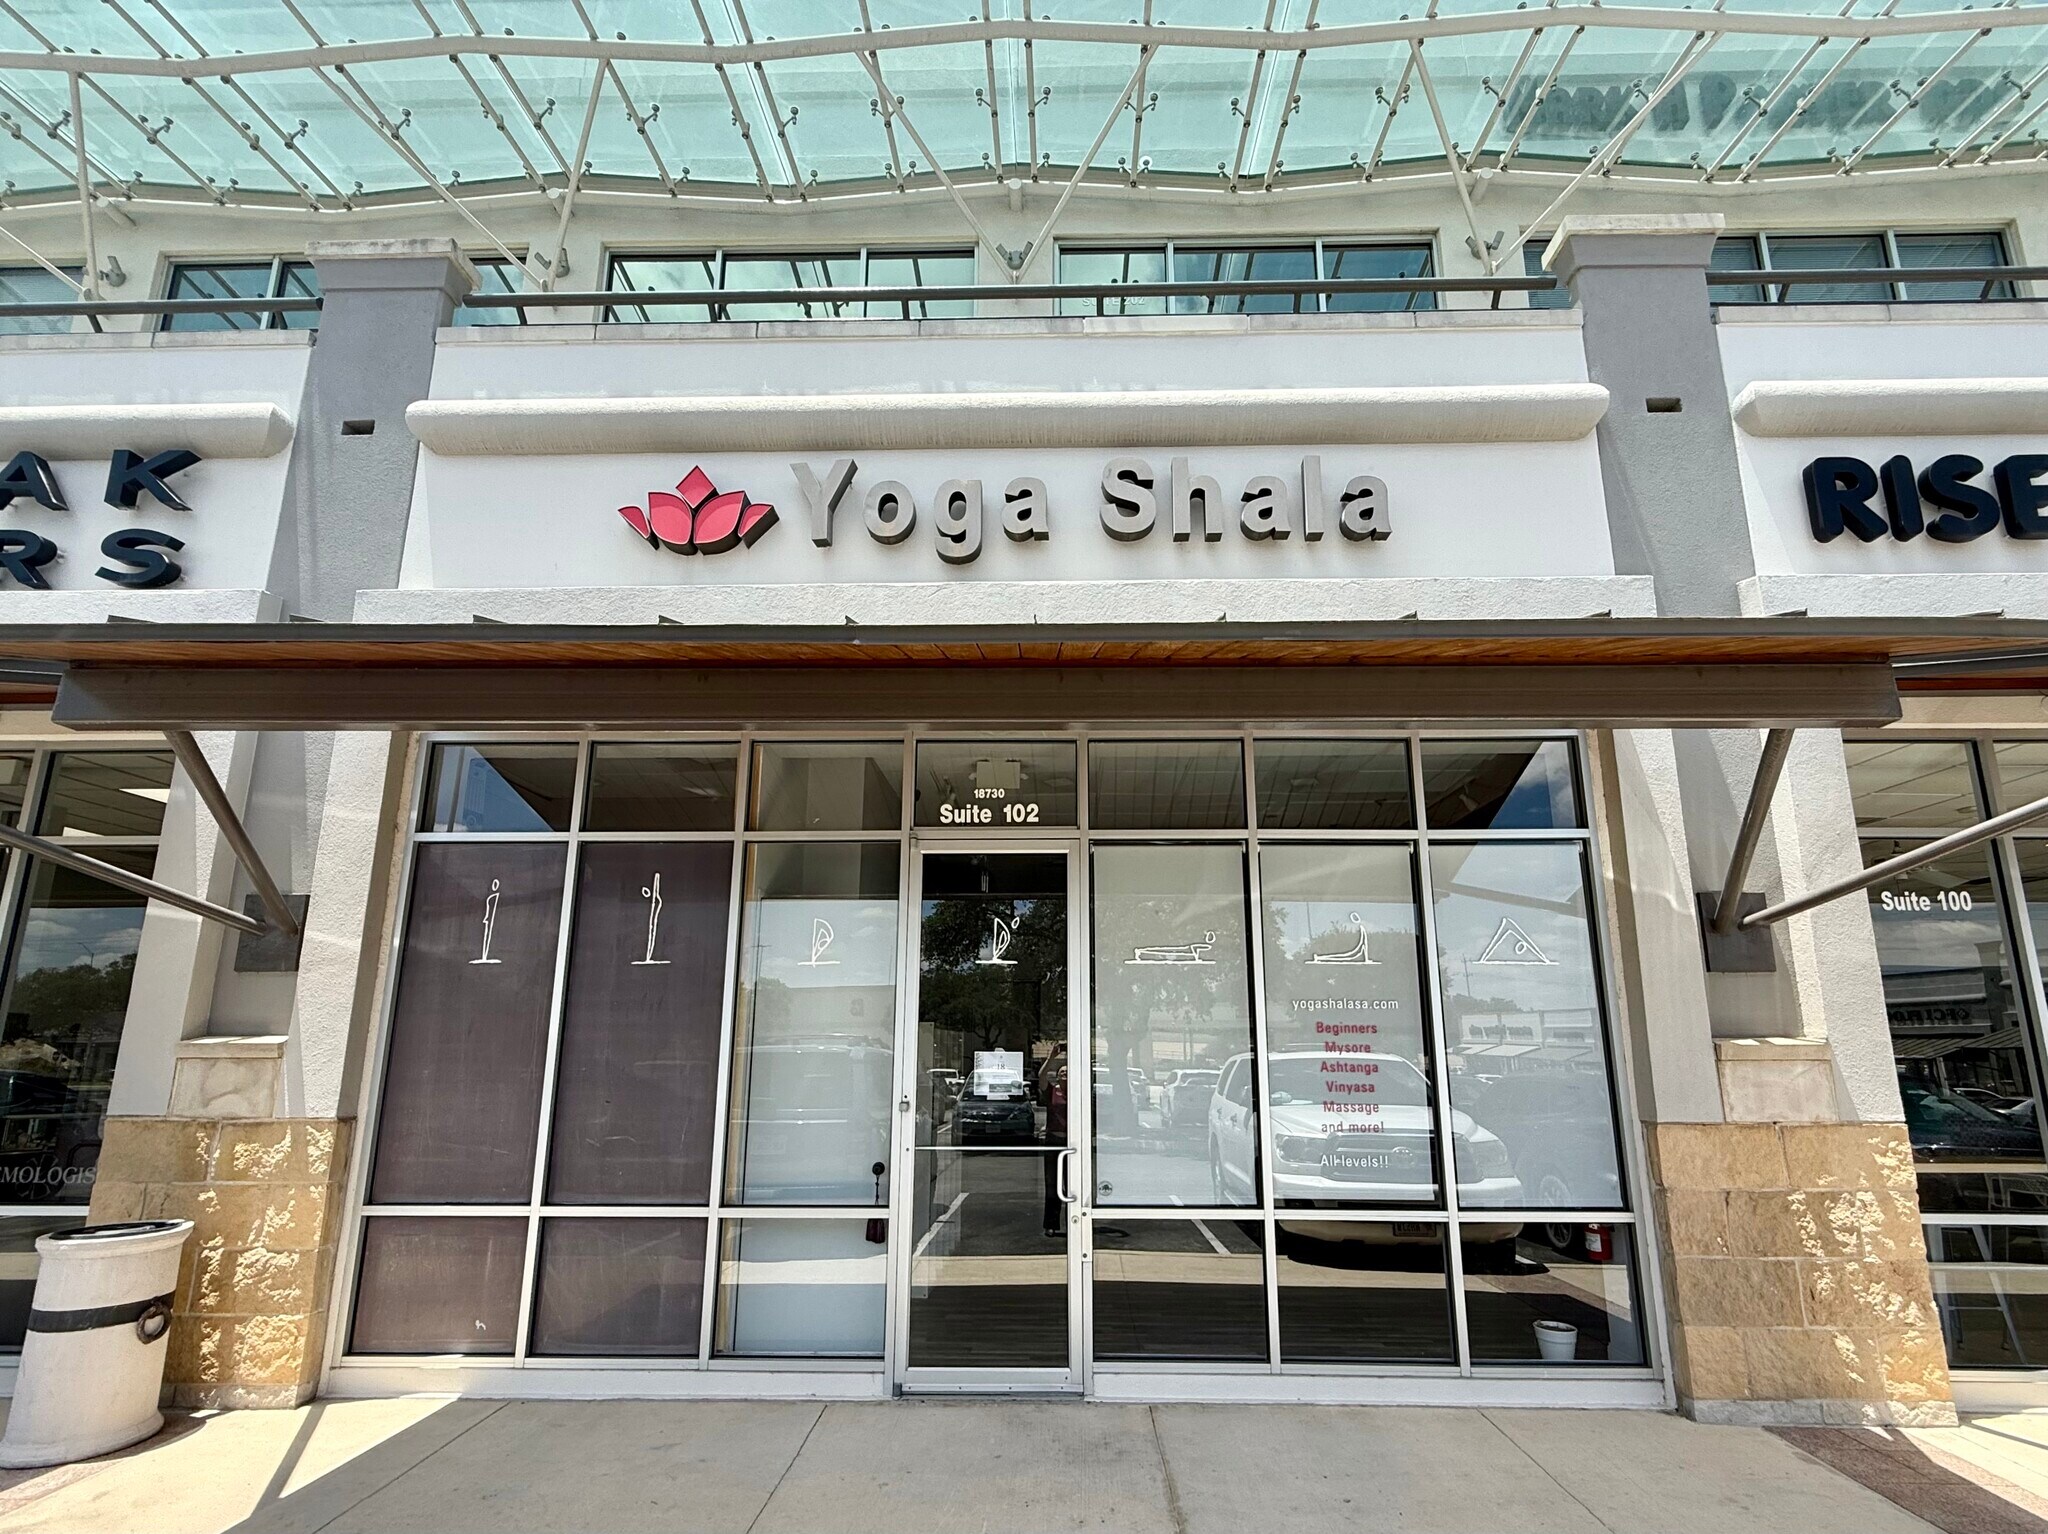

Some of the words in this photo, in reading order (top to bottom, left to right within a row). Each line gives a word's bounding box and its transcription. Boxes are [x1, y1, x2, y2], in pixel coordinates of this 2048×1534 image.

[1802, 454, 2048, 543] RISE
[789, 457, 1050, 565] Yoga
[1099, 455, 1394, 544] Shala
[973, 788, 1006, 799] 18730
[939, 803, 992, 824] Suite
[1003, 803, 1040, 823] 102
[1880, 891, 1931, 911] Suite
[1936, 890, 1972, 911] 100
[1292, 998, 1399, 1011] yogashalasa.com
[1316, 1021, 1378, 1035] Beginners
[1325, 1042, 1371, 1055] Mysore
[1320, 1061, 1379, 1075] Ashtanga
[1326, 1081, 1376, 1095] Vinyasa
[1323, 1101, 1379, 1115] Massage
[1321, 1121, 1344, 1133] and
[1348, 1121, 1385, 1133] more!
[0, 1166, 97, 1185] MOLOGIS
